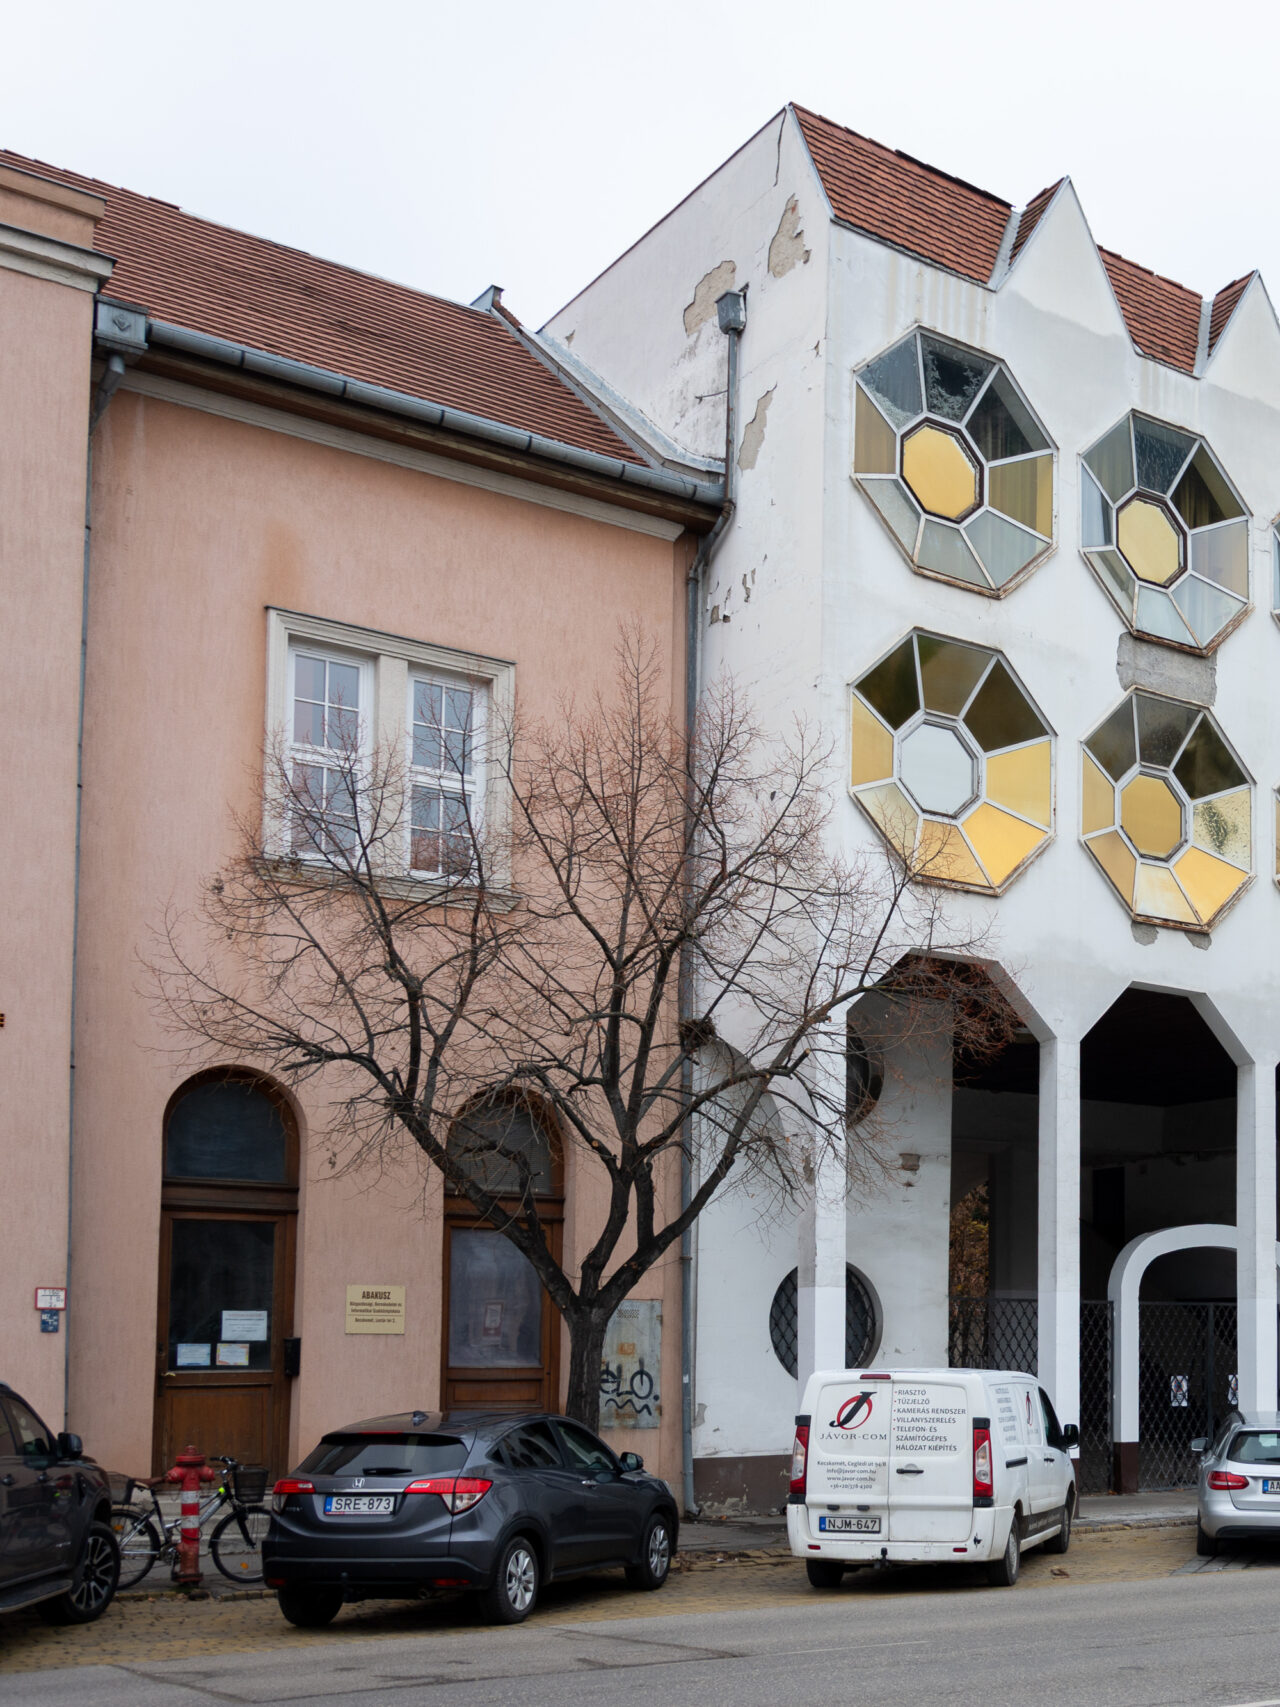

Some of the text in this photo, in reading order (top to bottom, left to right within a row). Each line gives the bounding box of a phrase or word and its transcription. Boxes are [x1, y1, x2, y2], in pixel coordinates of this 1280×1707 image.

[361, 1290, 392, 1300] ABAKUSZ
[896, 1406, 930, 1414] KAMERÁS
[896, 1416, 957, 1424] VILLANYSZERELÉS
[819, 1432, 888, 1441] JÁVOR-COM
[928, 1444, 958, 1452] KIÉPÍTÉS
[334, 1497, 391, 1511] SRE-873
[827, 1518, 878, 1530] NJM-647
